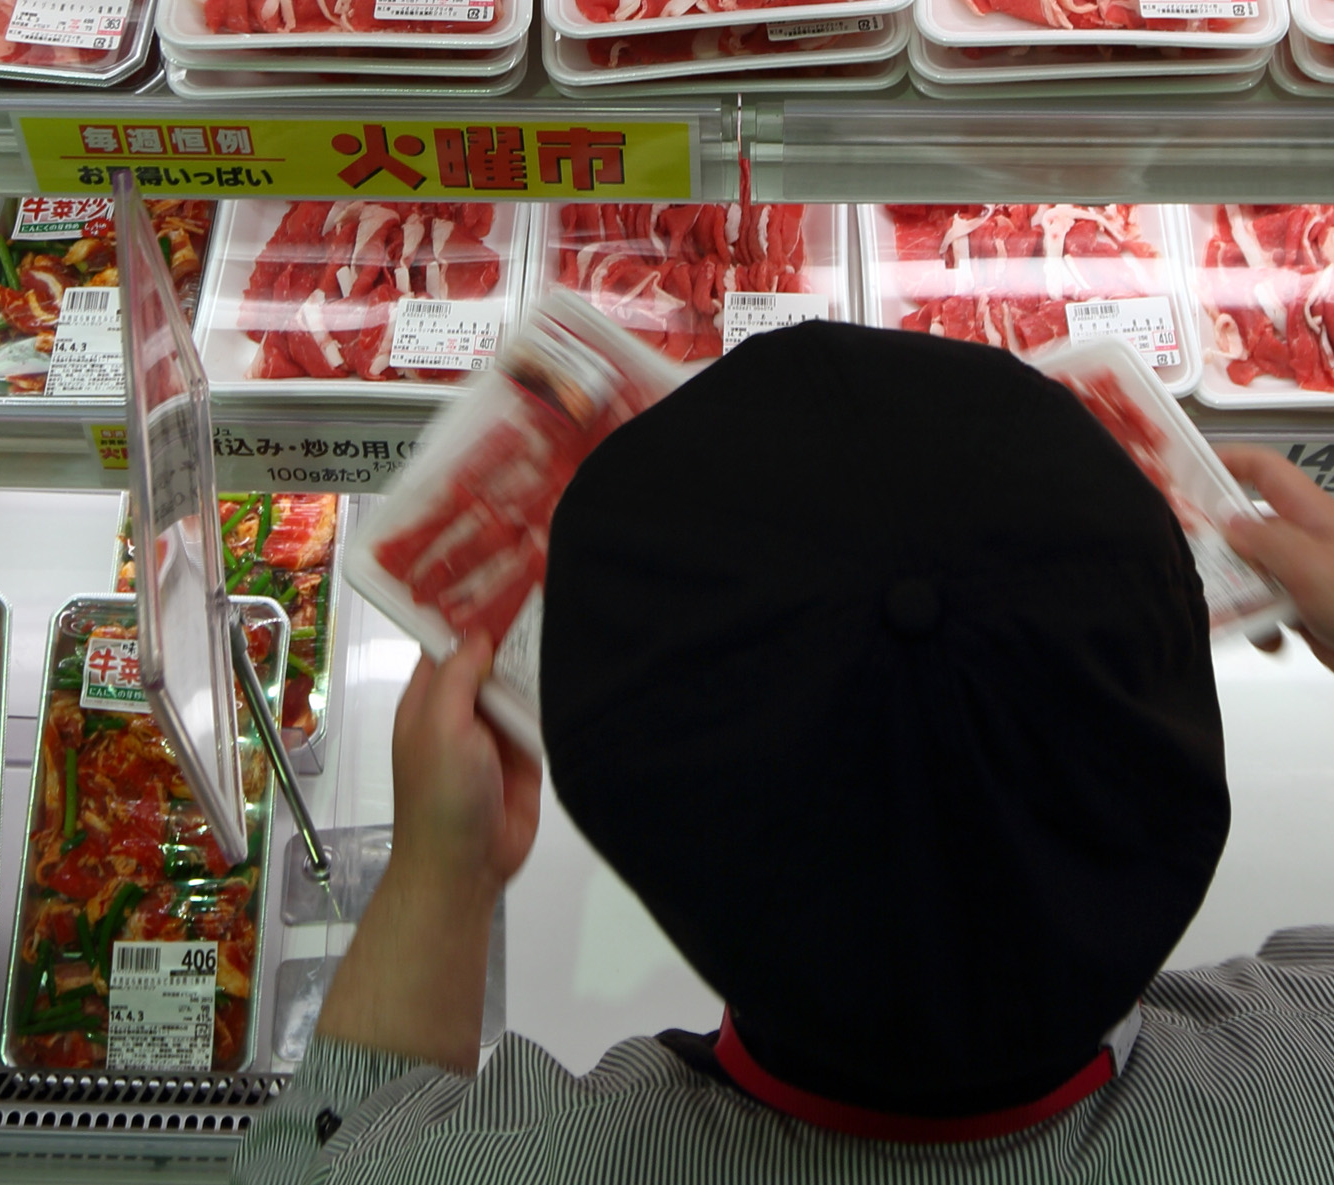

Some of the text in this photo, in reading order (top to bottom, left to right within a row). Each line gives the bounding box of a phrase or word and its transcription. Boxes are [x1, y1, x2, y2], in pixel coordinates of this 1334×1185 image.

[82, 125, 253, 154] 毎週恒例
[330, 123, 626, 192] 火曜市
[268, 465, 372, 484] 100gあたり
[182, 949, 216, 969] 406
